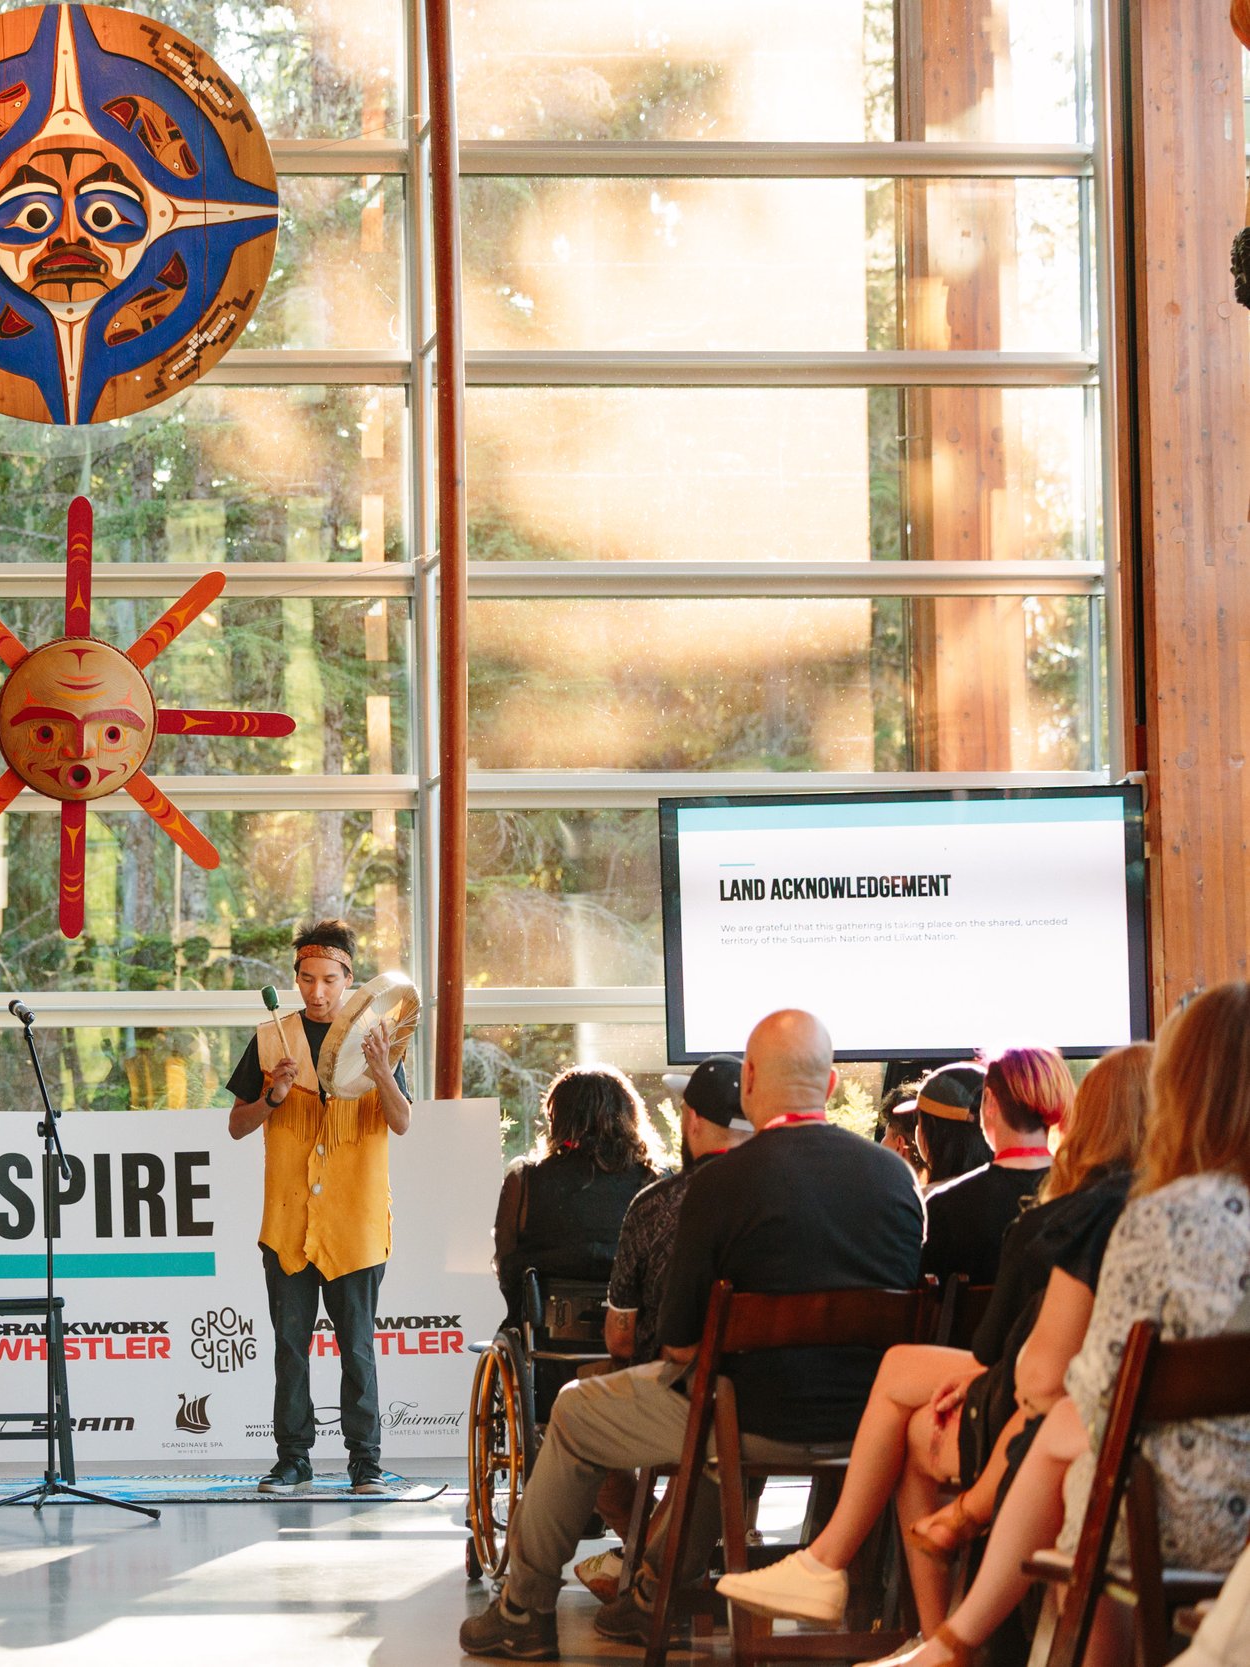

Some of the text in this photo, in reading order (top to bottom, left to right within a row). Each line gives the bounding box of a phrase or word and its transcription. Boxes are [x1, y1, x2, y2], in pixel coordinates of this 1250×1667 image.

[719, 874, 951, 901] LAND ACKNOWLEDGEMENT
[720, 924, 736, 932] We
[755, 923, 791, 934] grateful
[794, 923, 813, 931] that
[816, 922, 834, 931] this
[836, 922, 882, 931] gathering
[884, 921, 892, 929] is
[894, 921, 924, 930] taking
[927, 920, 952, 930] place
[954, 920, 967, 928] on
[969, 919, 986, 927] the
[988, 918, 1023, 927] shared,
[1025, 917, 1068, 926] unceded
[721, 937, 758, 946] territory
[760, 935, 771, 944] of
[772, 935, 788, 944] the
[790, 935, 837, 945] Squamish
[839, 934, 871, 943] Nation
[873, 934, 891, 942] and
[924, 932, 958, 941] Nation.
[191, 1307, 253, 1338] GROW
[313, 1315, 462, 1331] AWORX
[308, 1331, 464, 1357] HTLER
[380, 1401, 465, 1429] Fairmont
